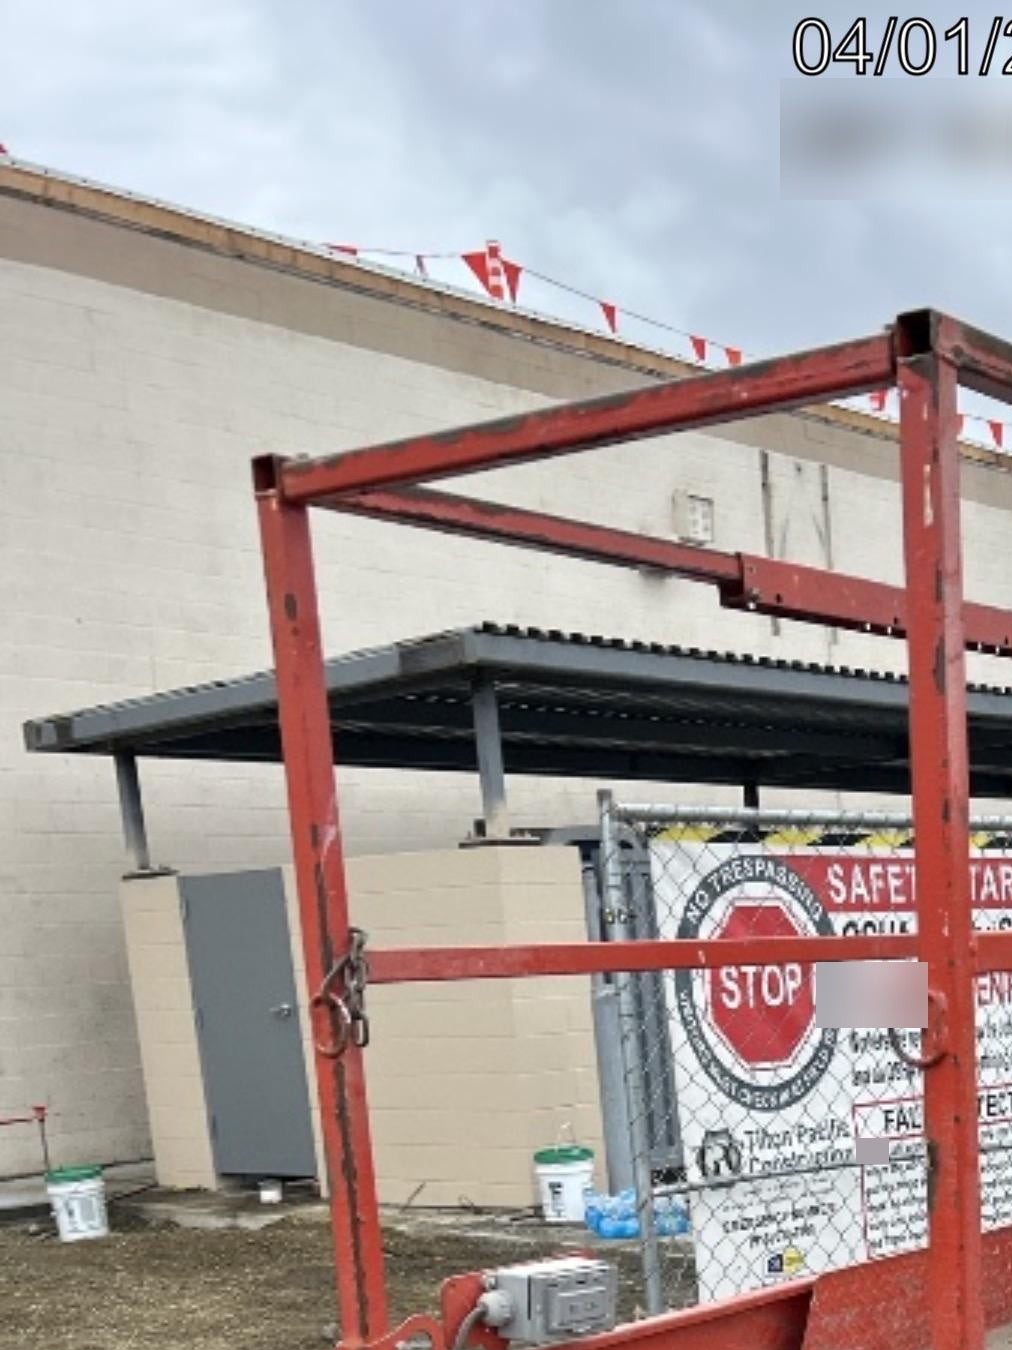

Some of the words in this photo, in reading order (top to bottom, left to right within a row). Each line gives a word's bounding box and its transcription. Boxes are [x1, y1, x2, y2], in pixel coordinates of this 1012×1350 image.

[686, 889, 709, 925] NO
[707, 857, 823, 922] TRESPASSING
[827, 862, 916, 905] SAFET
[720, 964, 802, 1010] STOP
[882, 1103, 922, 1134] FAL
